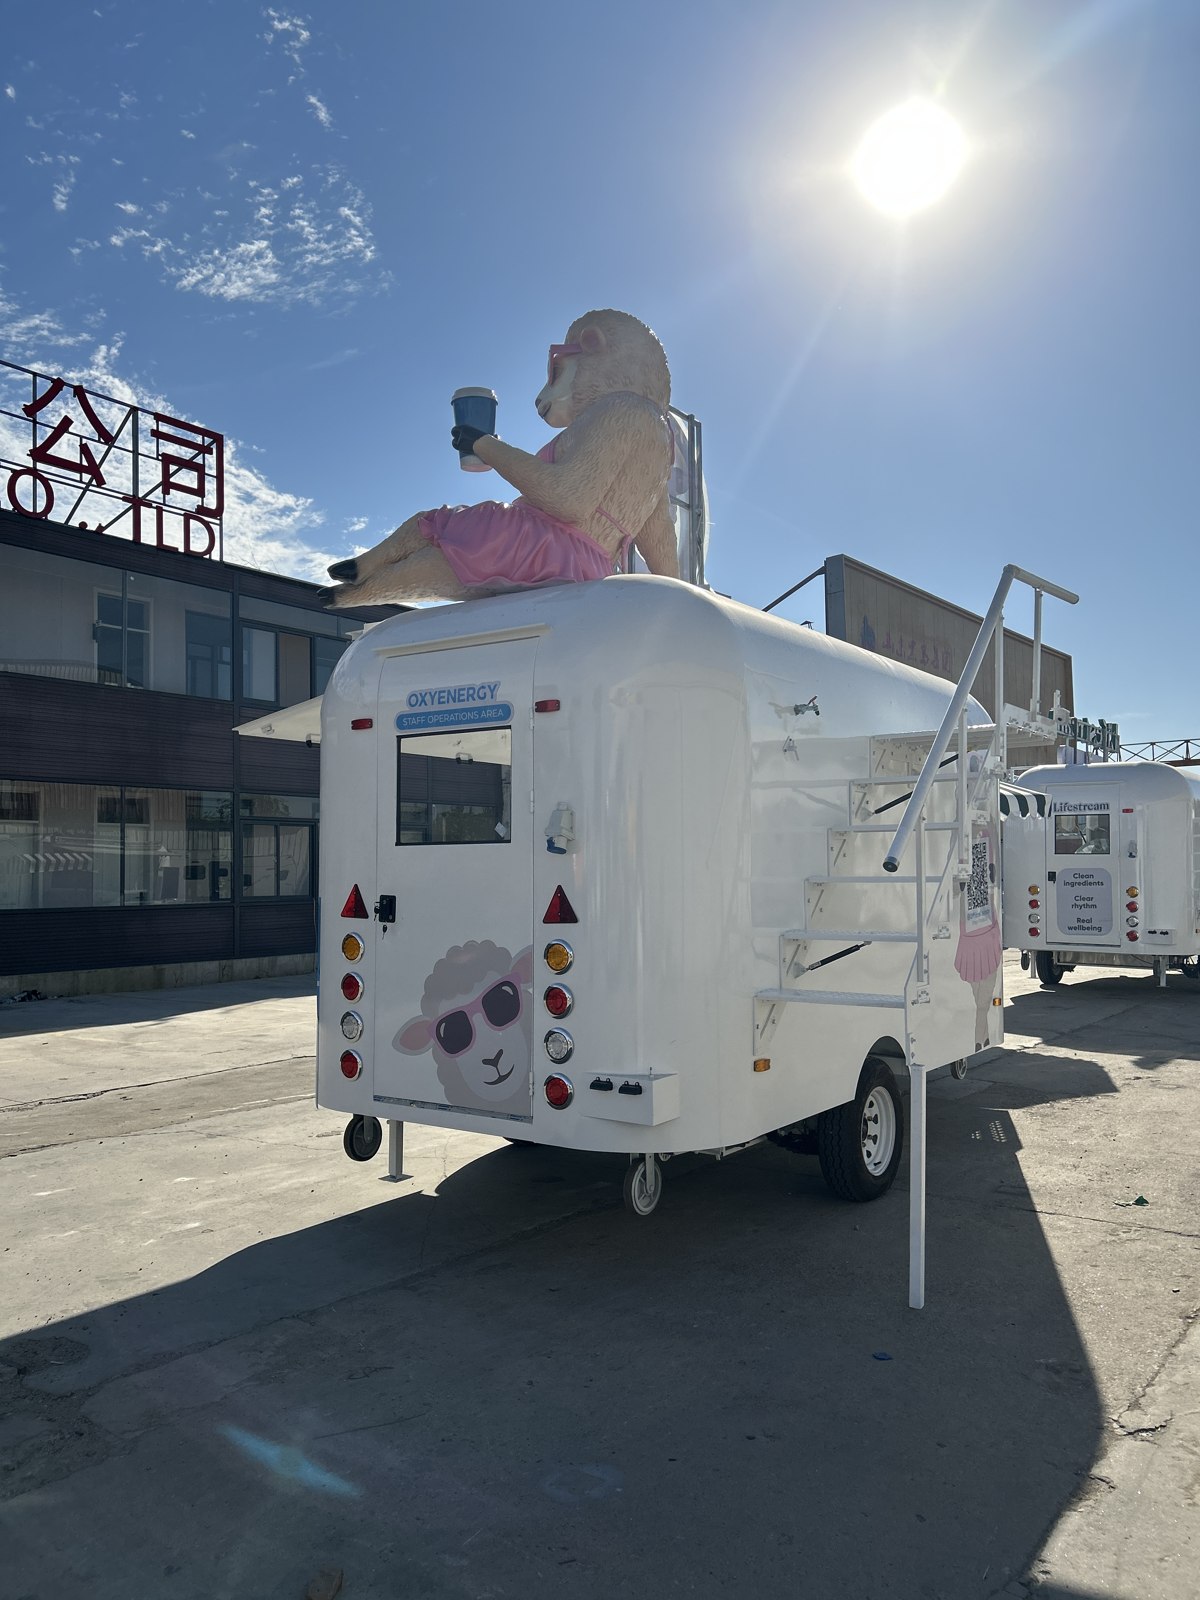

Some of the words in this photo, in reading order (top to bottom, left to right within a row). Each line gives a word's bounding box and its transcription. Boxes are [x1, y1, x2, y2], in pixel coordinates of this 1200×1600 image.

[22, 377, 224, 519] 公司
[408, 683, 498, 708] OXYENERGY
[402, 716, 426, 726] STAFF
[427, 710, 479, 724] OPERATIONS
[480, 708, 504, 719] AREA
[1053, 802, 1110, 813] Lifestream
[1072, 872, 1095, 880] Clean
[1063, 880, 1104, 888] ingredients
[1067, 924, 1103, 933] wellbeing
